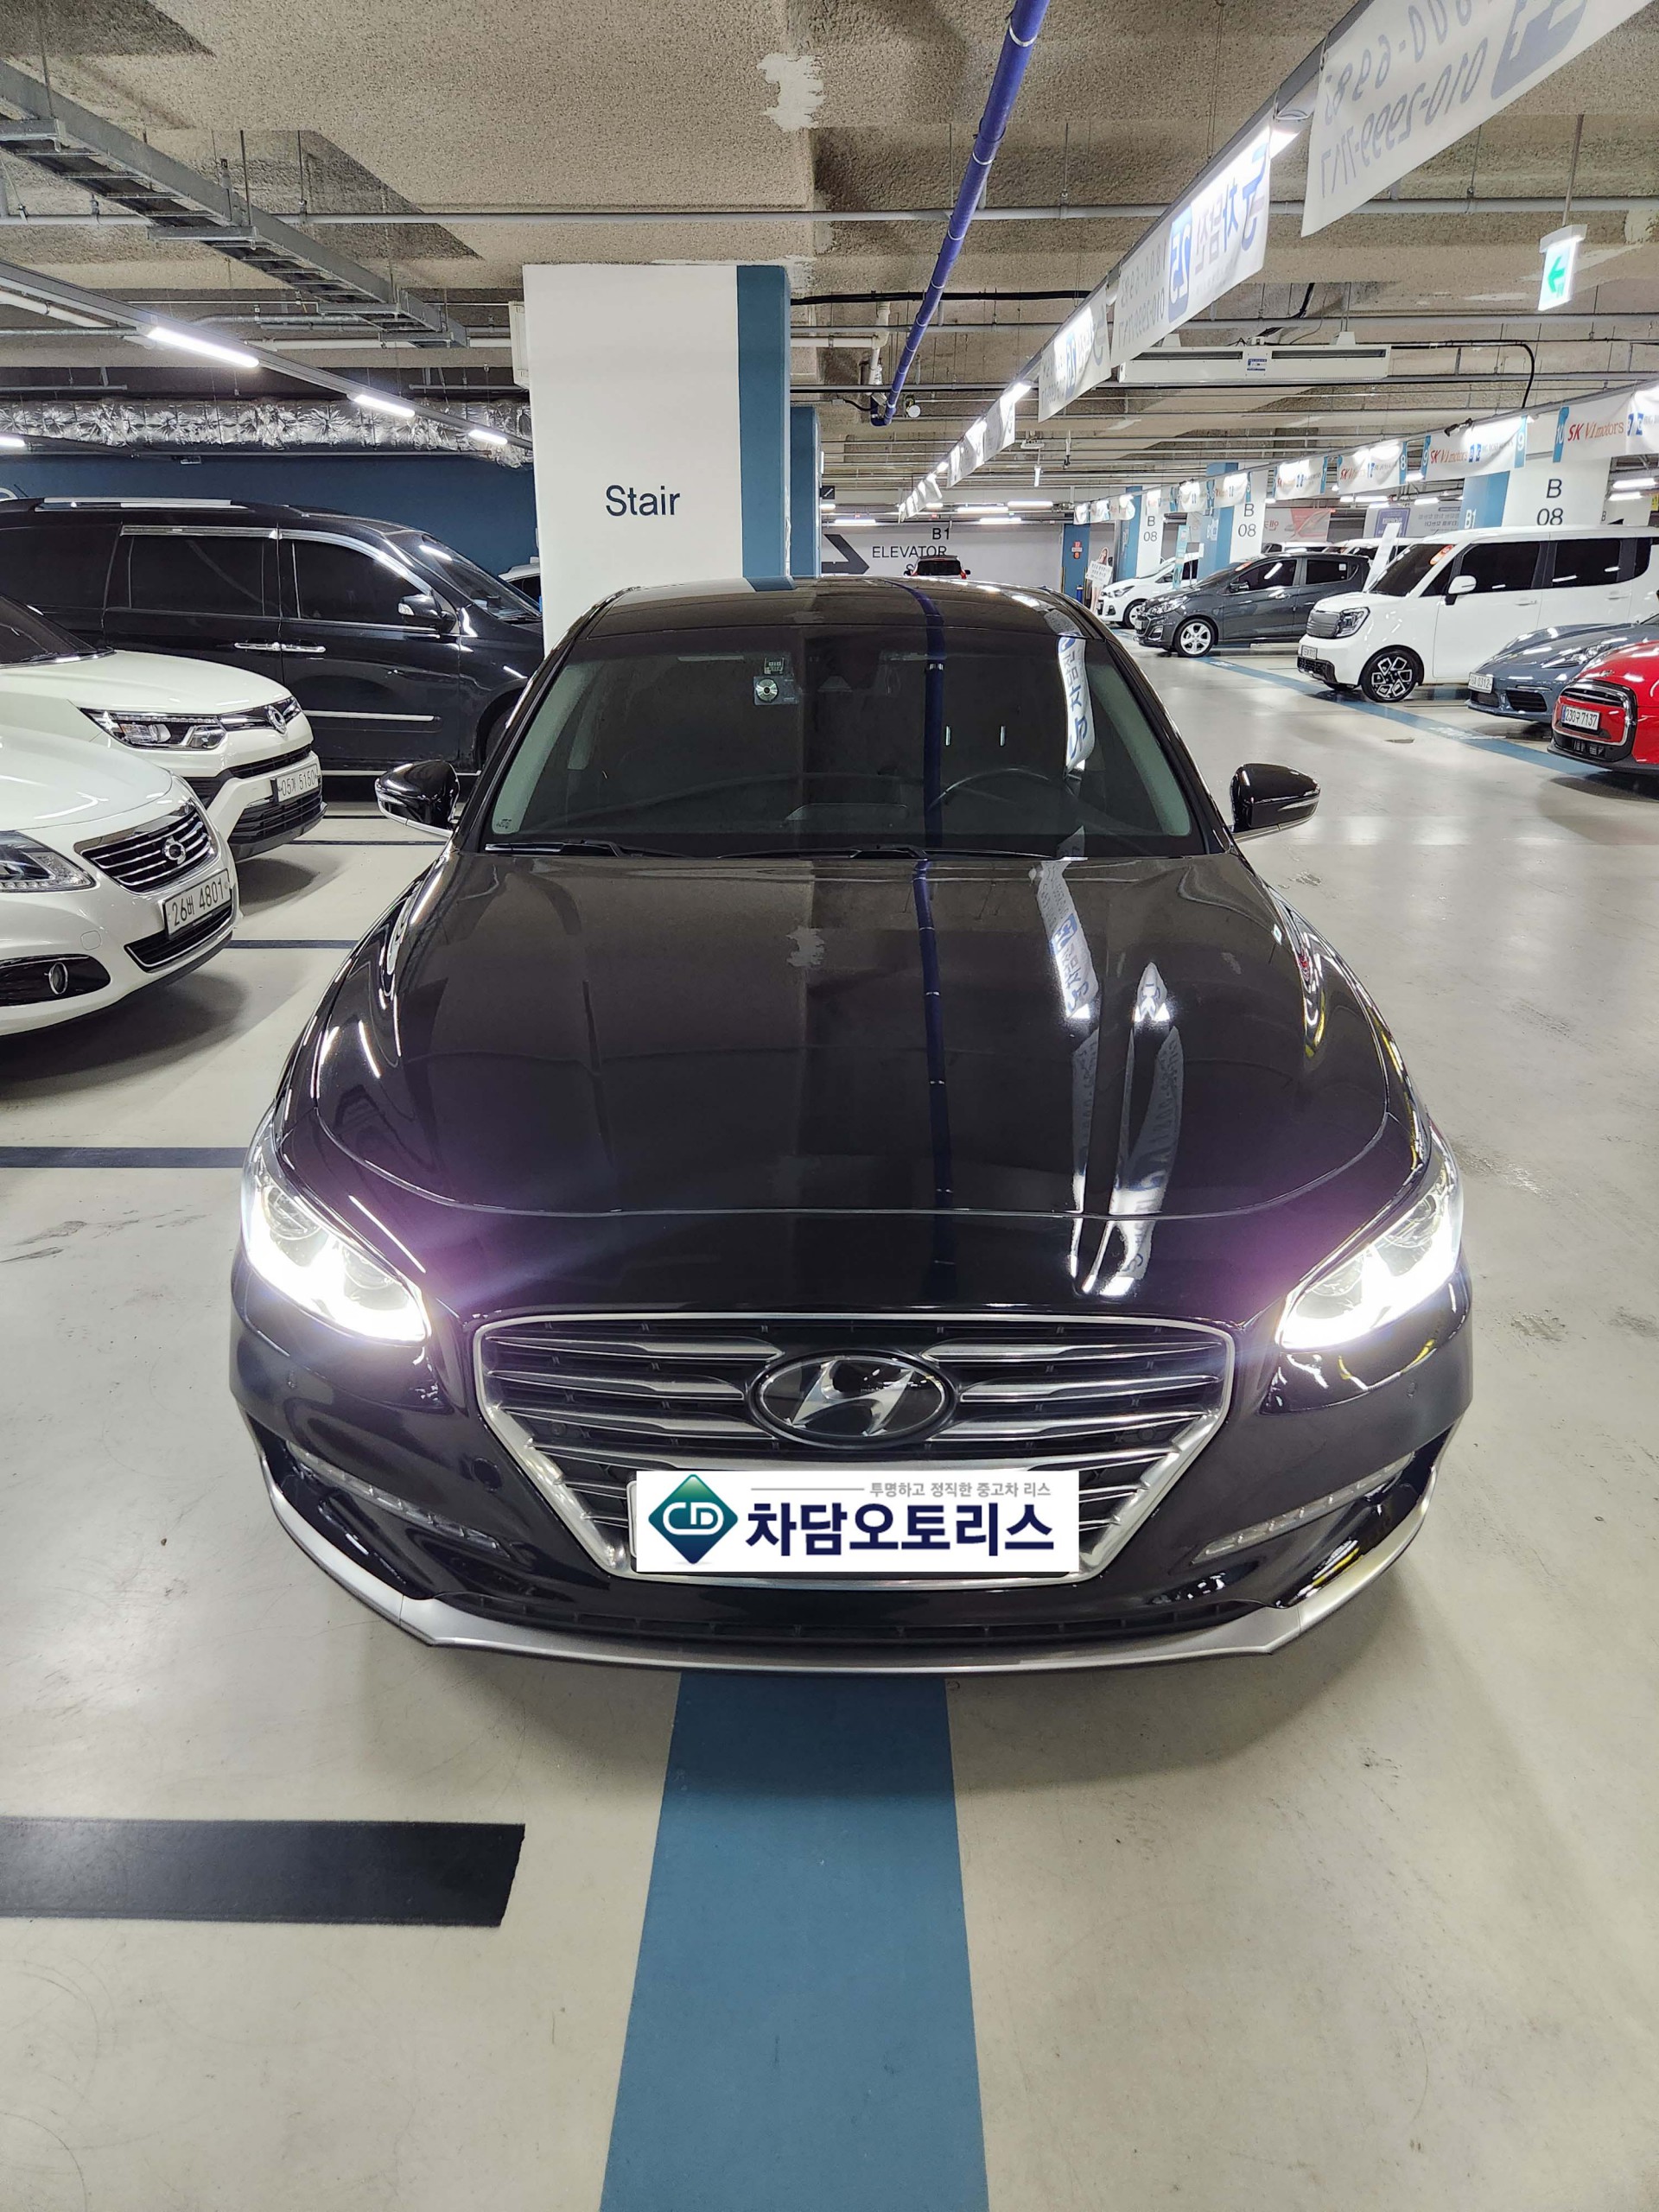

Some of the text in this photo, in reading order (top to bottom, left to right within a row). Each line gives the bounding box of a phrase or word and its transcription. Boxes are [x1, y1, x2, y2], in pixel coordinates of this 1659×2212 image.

[1567, 423, 1584, 442] SK
[1517, 432, 1525, 451] 9
[1400, 454, 1406, 470] 8
[1546, 479, 1563, 499] B
[606, 485, 680, 516] Stair
[1244, 503, 1255, 517] B
[1536, 507, 1563, 526] 08
[1147, 516, 1155, 526] B
[932, 527, 950, 540] B1
[1143, 531, 1157, 542] 08
[1238, 524, 1256, 537] 08
[872, 545, 947, 558] ELEVATOR
[1581, 711, 1598, 728] 7137
[199, 877, 224, 910] 4801
